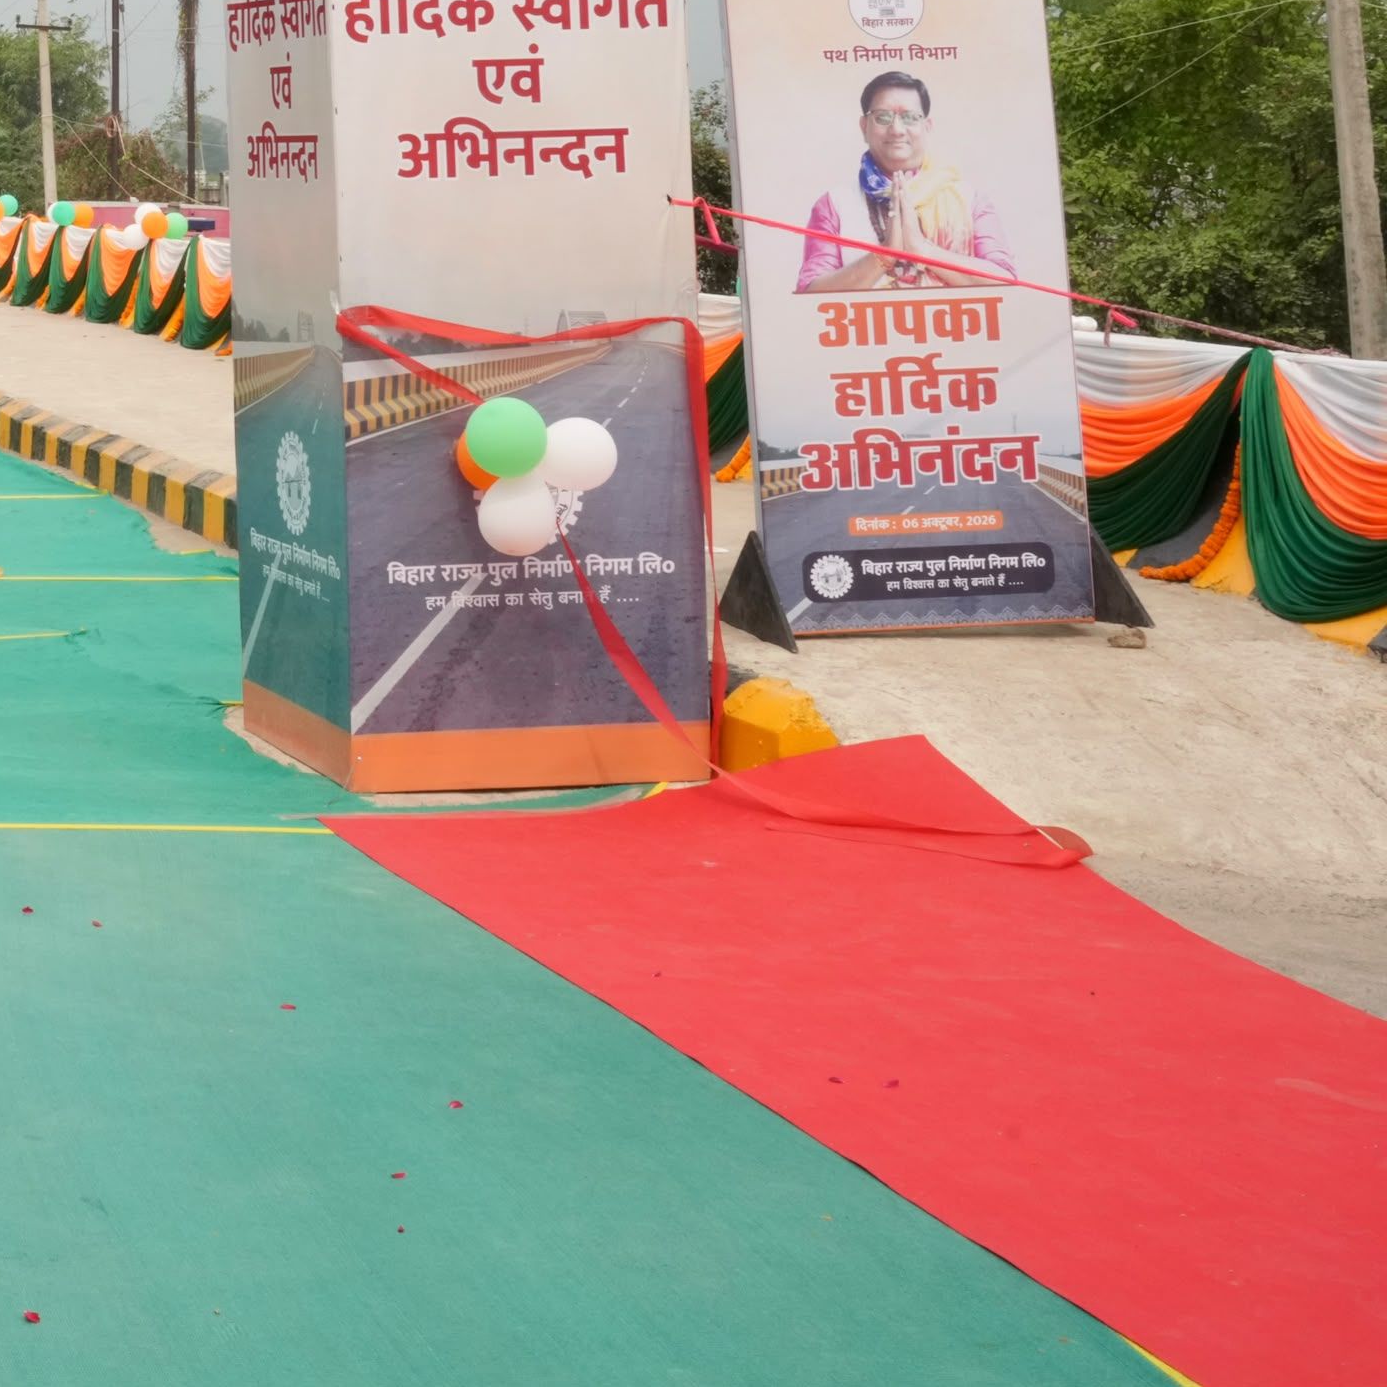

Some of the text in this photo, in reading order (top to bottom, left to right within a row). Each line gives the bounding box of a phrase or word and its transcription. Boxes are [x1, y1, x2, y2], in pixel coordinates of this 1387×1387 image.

[472, 43, 544, 104] एवं
[823, 43, 957, 63] पथ निर्माण विभाग
[270, 52, 291, 109] एवं
[247, 121, 318, 183] अभिनन्दन
[397, 117, 629, 179] अभिनन्दन
[817, 296, 1003, 348] आपका
[829, 352, 999, 417] हार्दिक
[799, 426, 1041, 490] अभिनंदन
[902, 518, 920, 529] 06
[966, 515, 996, 527] 2026
[387, 561, 436, 586] बिहार
[440, 564, 483, 581] राज्य
[488, 562, 518, 586] पुल
[585, 554, 633, 576] निगम
[861, 559, 893, 576] बिहार
[895, 560, 923, 573] राज्य
[925, 559, 946, 577] पुल
[948, 554, 986, 571] निर्माण
[988, 553, 1019, 569] निगम
[937, 579, 950, 588] का
[425, 596, 446, 610] हम
[505, 593, 523, 606] का
[529, 588, 553, 610] सेतु
